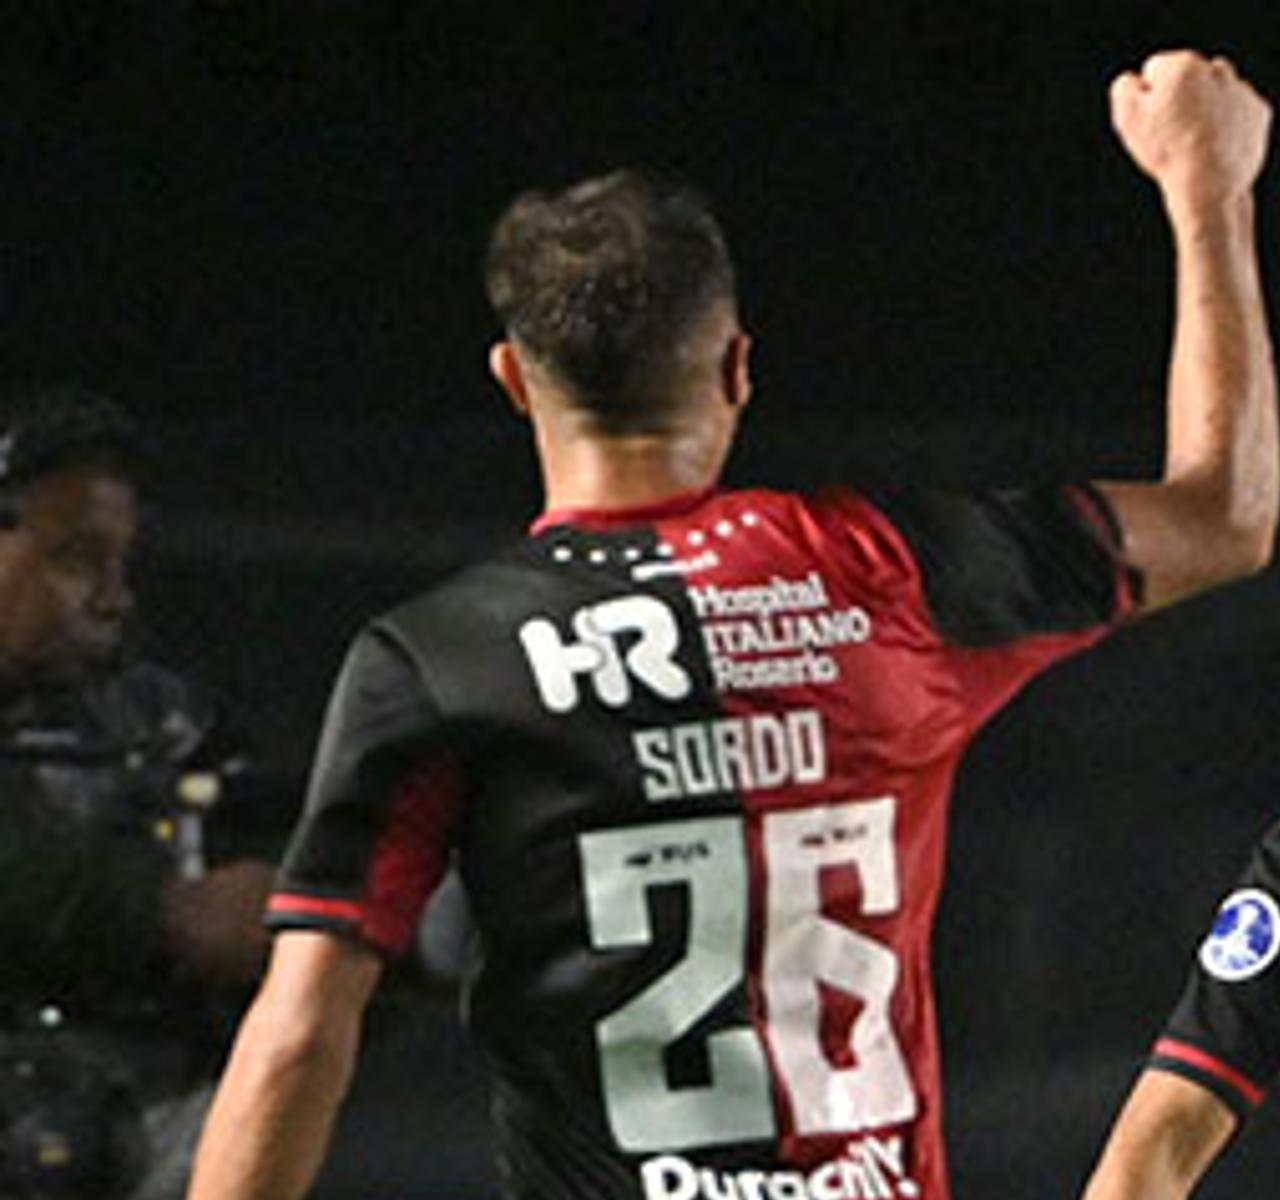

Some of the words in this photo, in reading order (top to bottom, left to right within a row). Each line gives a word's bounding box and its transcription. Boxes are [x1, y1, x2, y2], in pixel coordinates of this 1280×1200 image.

[687, 573, 829, 618] Hospital
[519, 595, 692, 712] HR
[701, 606, 871, 654] ITALIANO
[711, 655, 839, 691] Rosario
[632, 711, 827, 800] SORDO
[578, 797, 917, 1154] 26
